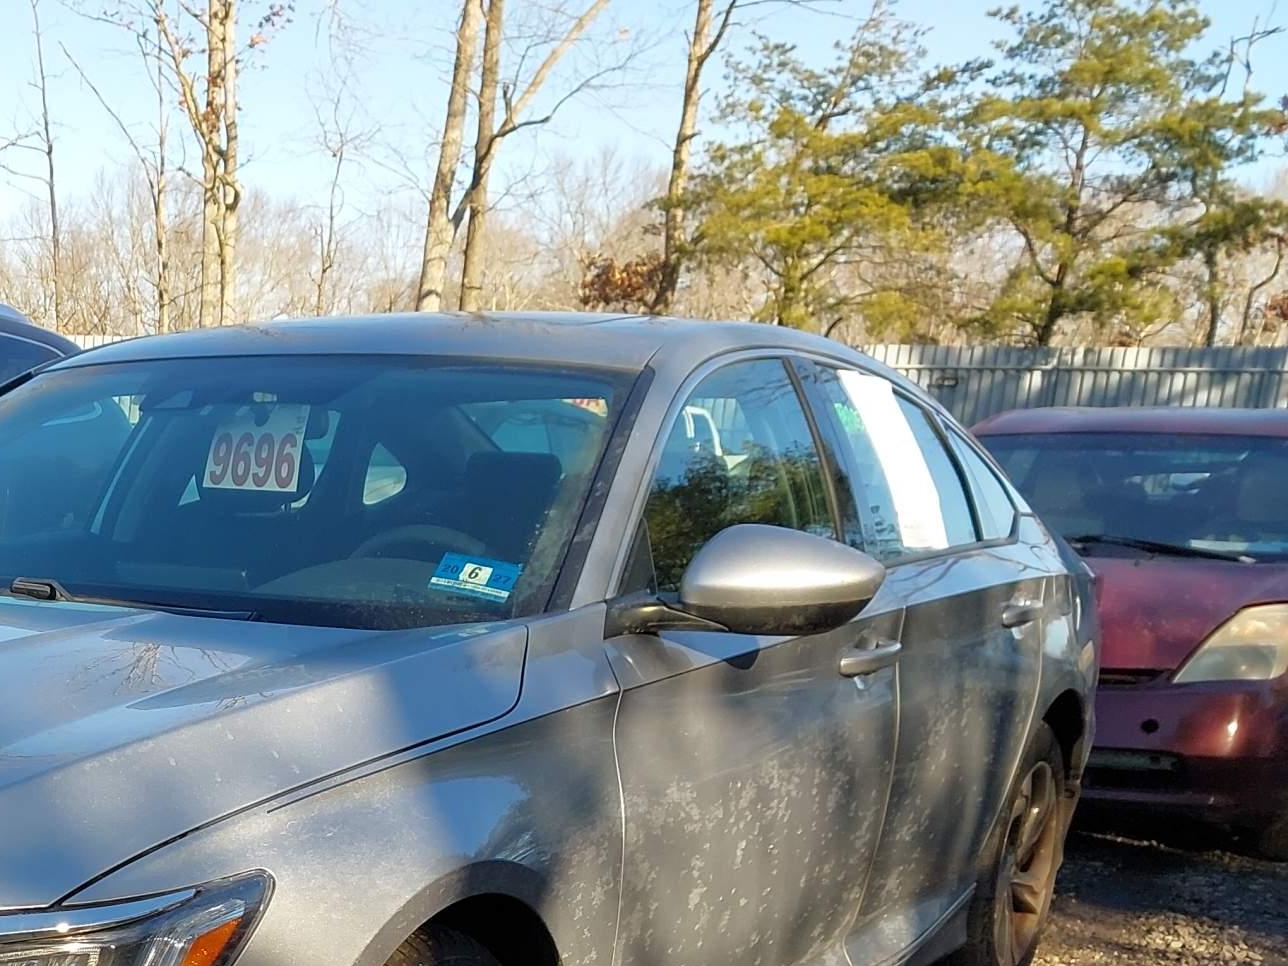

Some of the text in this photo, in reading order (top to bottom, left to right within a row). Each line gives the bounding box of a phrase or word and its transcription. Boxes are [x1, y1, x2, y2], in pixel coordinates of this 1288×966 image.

[209, 431, 298, 489] 9696
[440, 563, 460, 574] 20
[468, 566, 482, 580] 6
